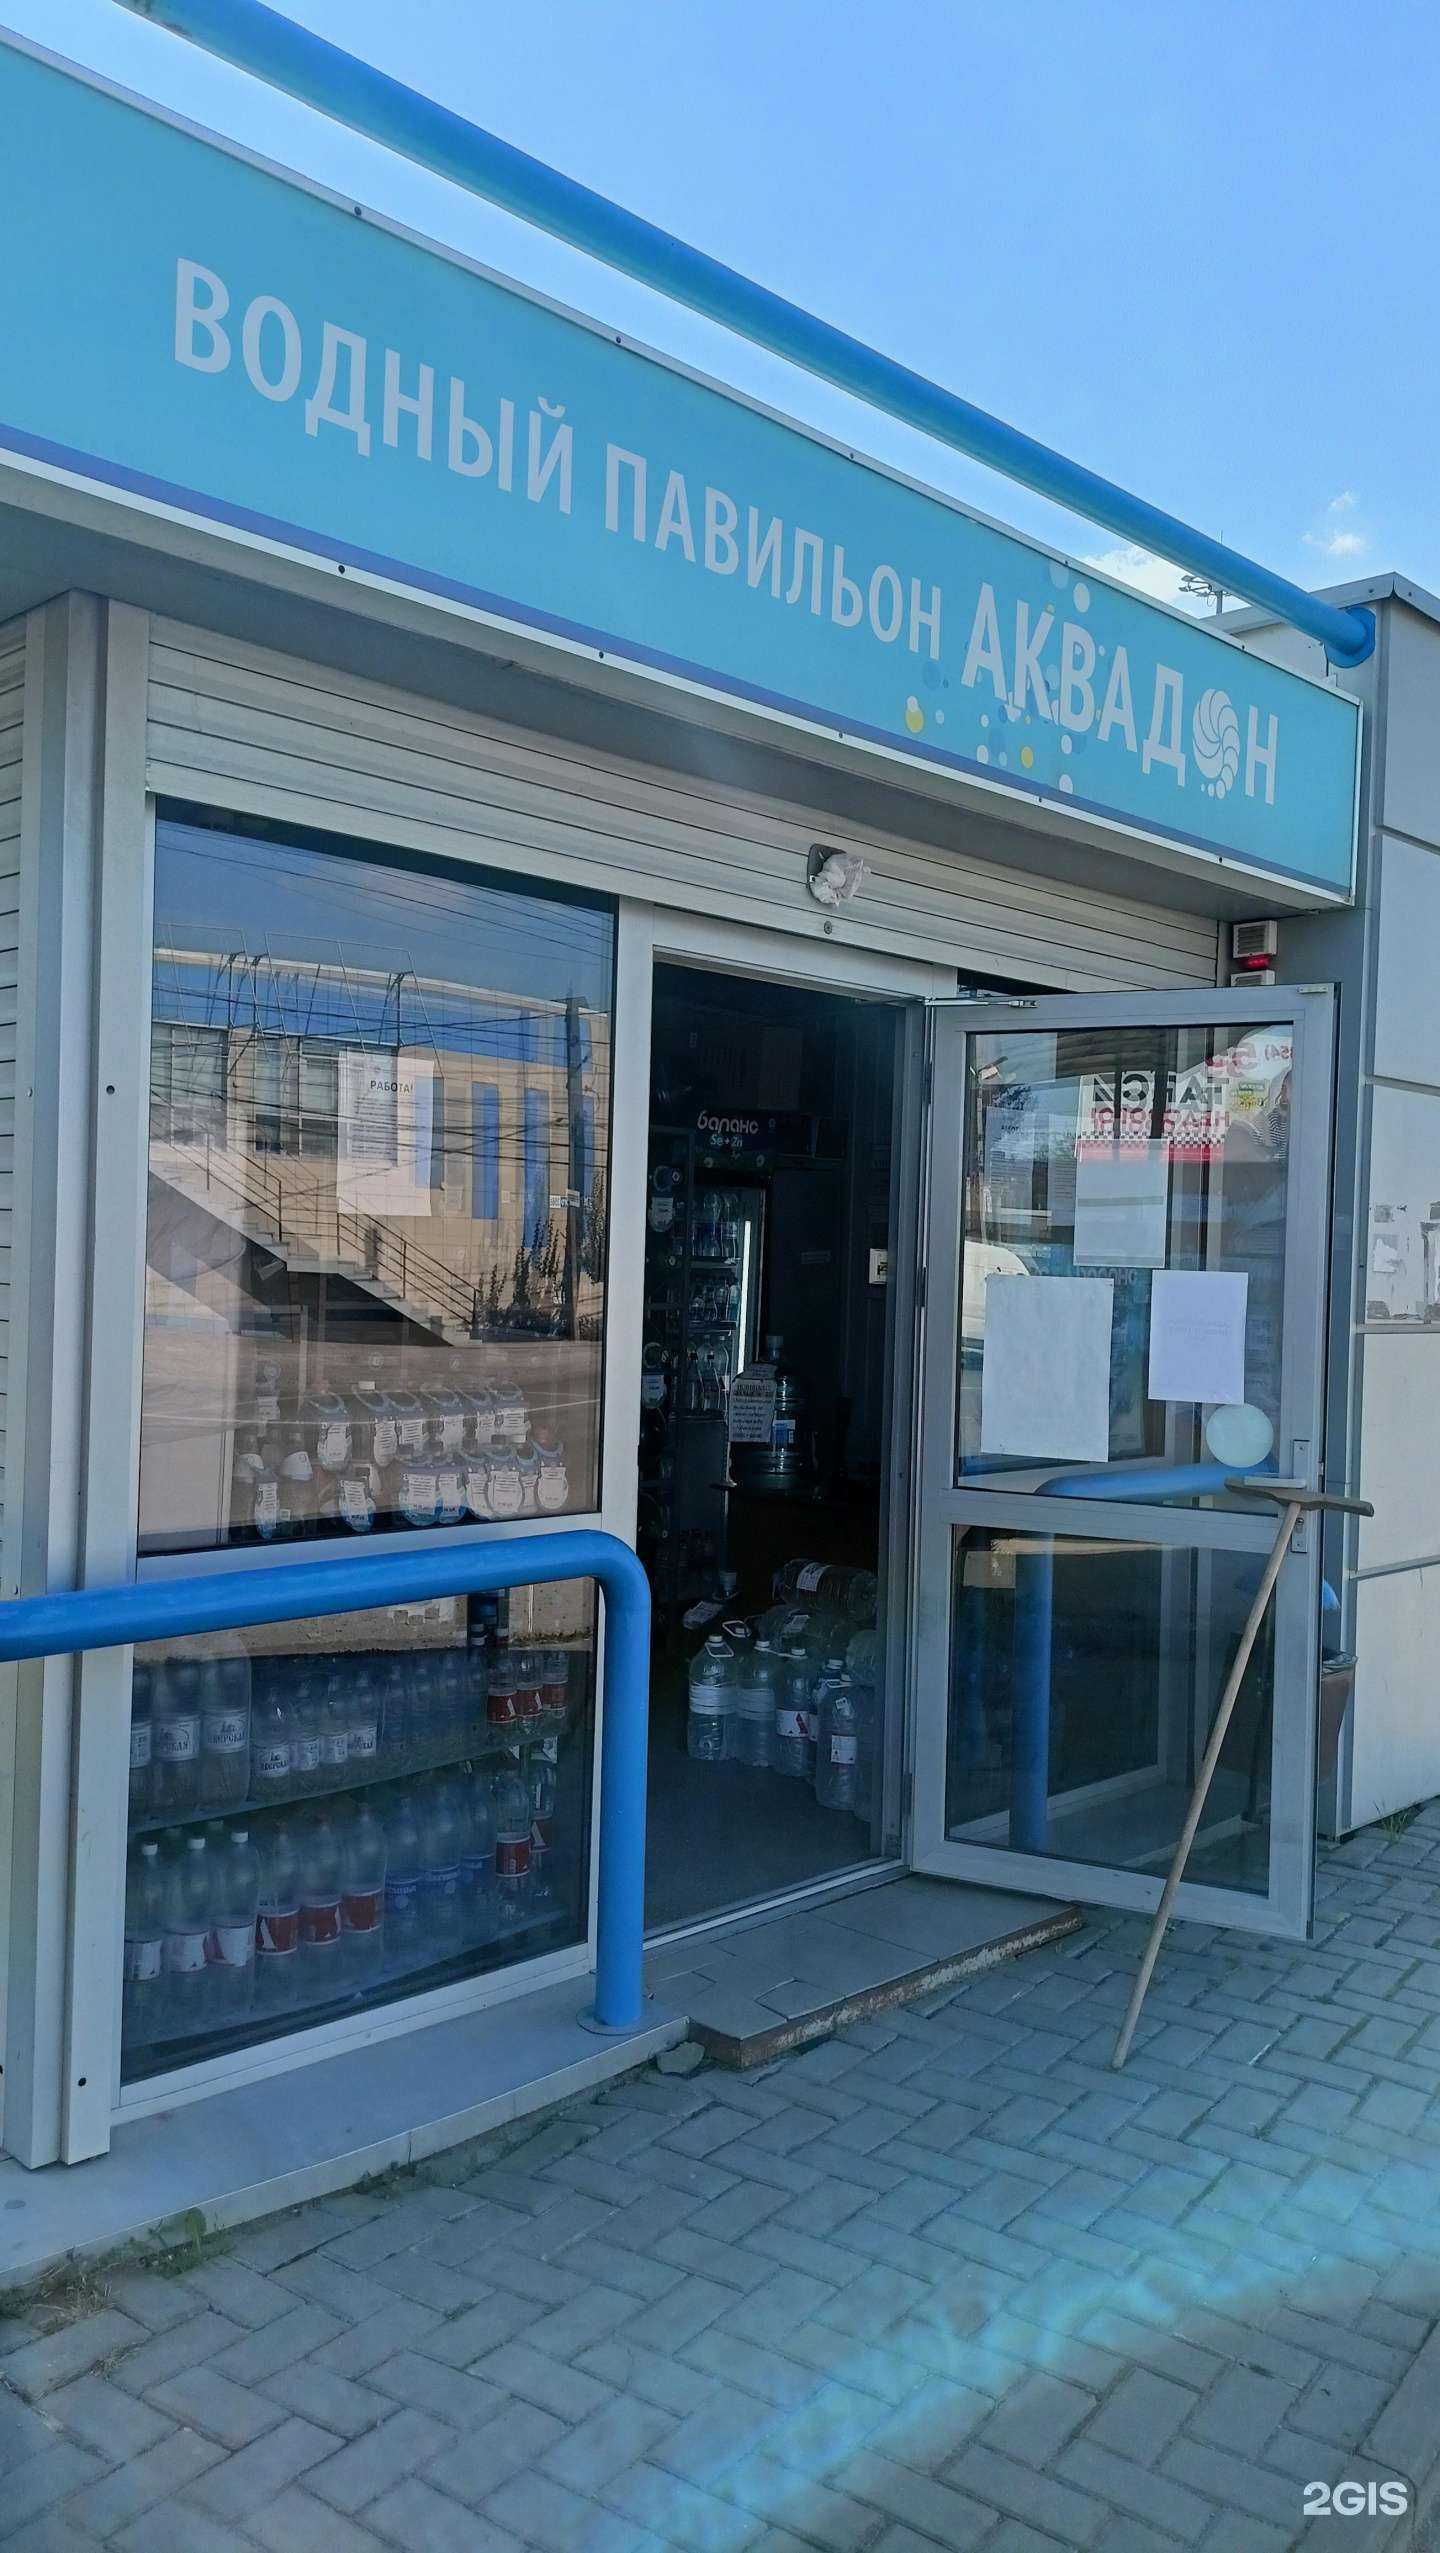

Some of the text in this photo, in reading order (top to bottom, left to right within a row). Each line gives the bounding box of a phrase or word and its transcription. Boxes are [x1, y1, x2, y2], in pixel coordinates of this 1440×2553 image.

[173, 257, 1279, 806] ВОДНЫЙ ПАВИЛЬОН АКВАДОН
